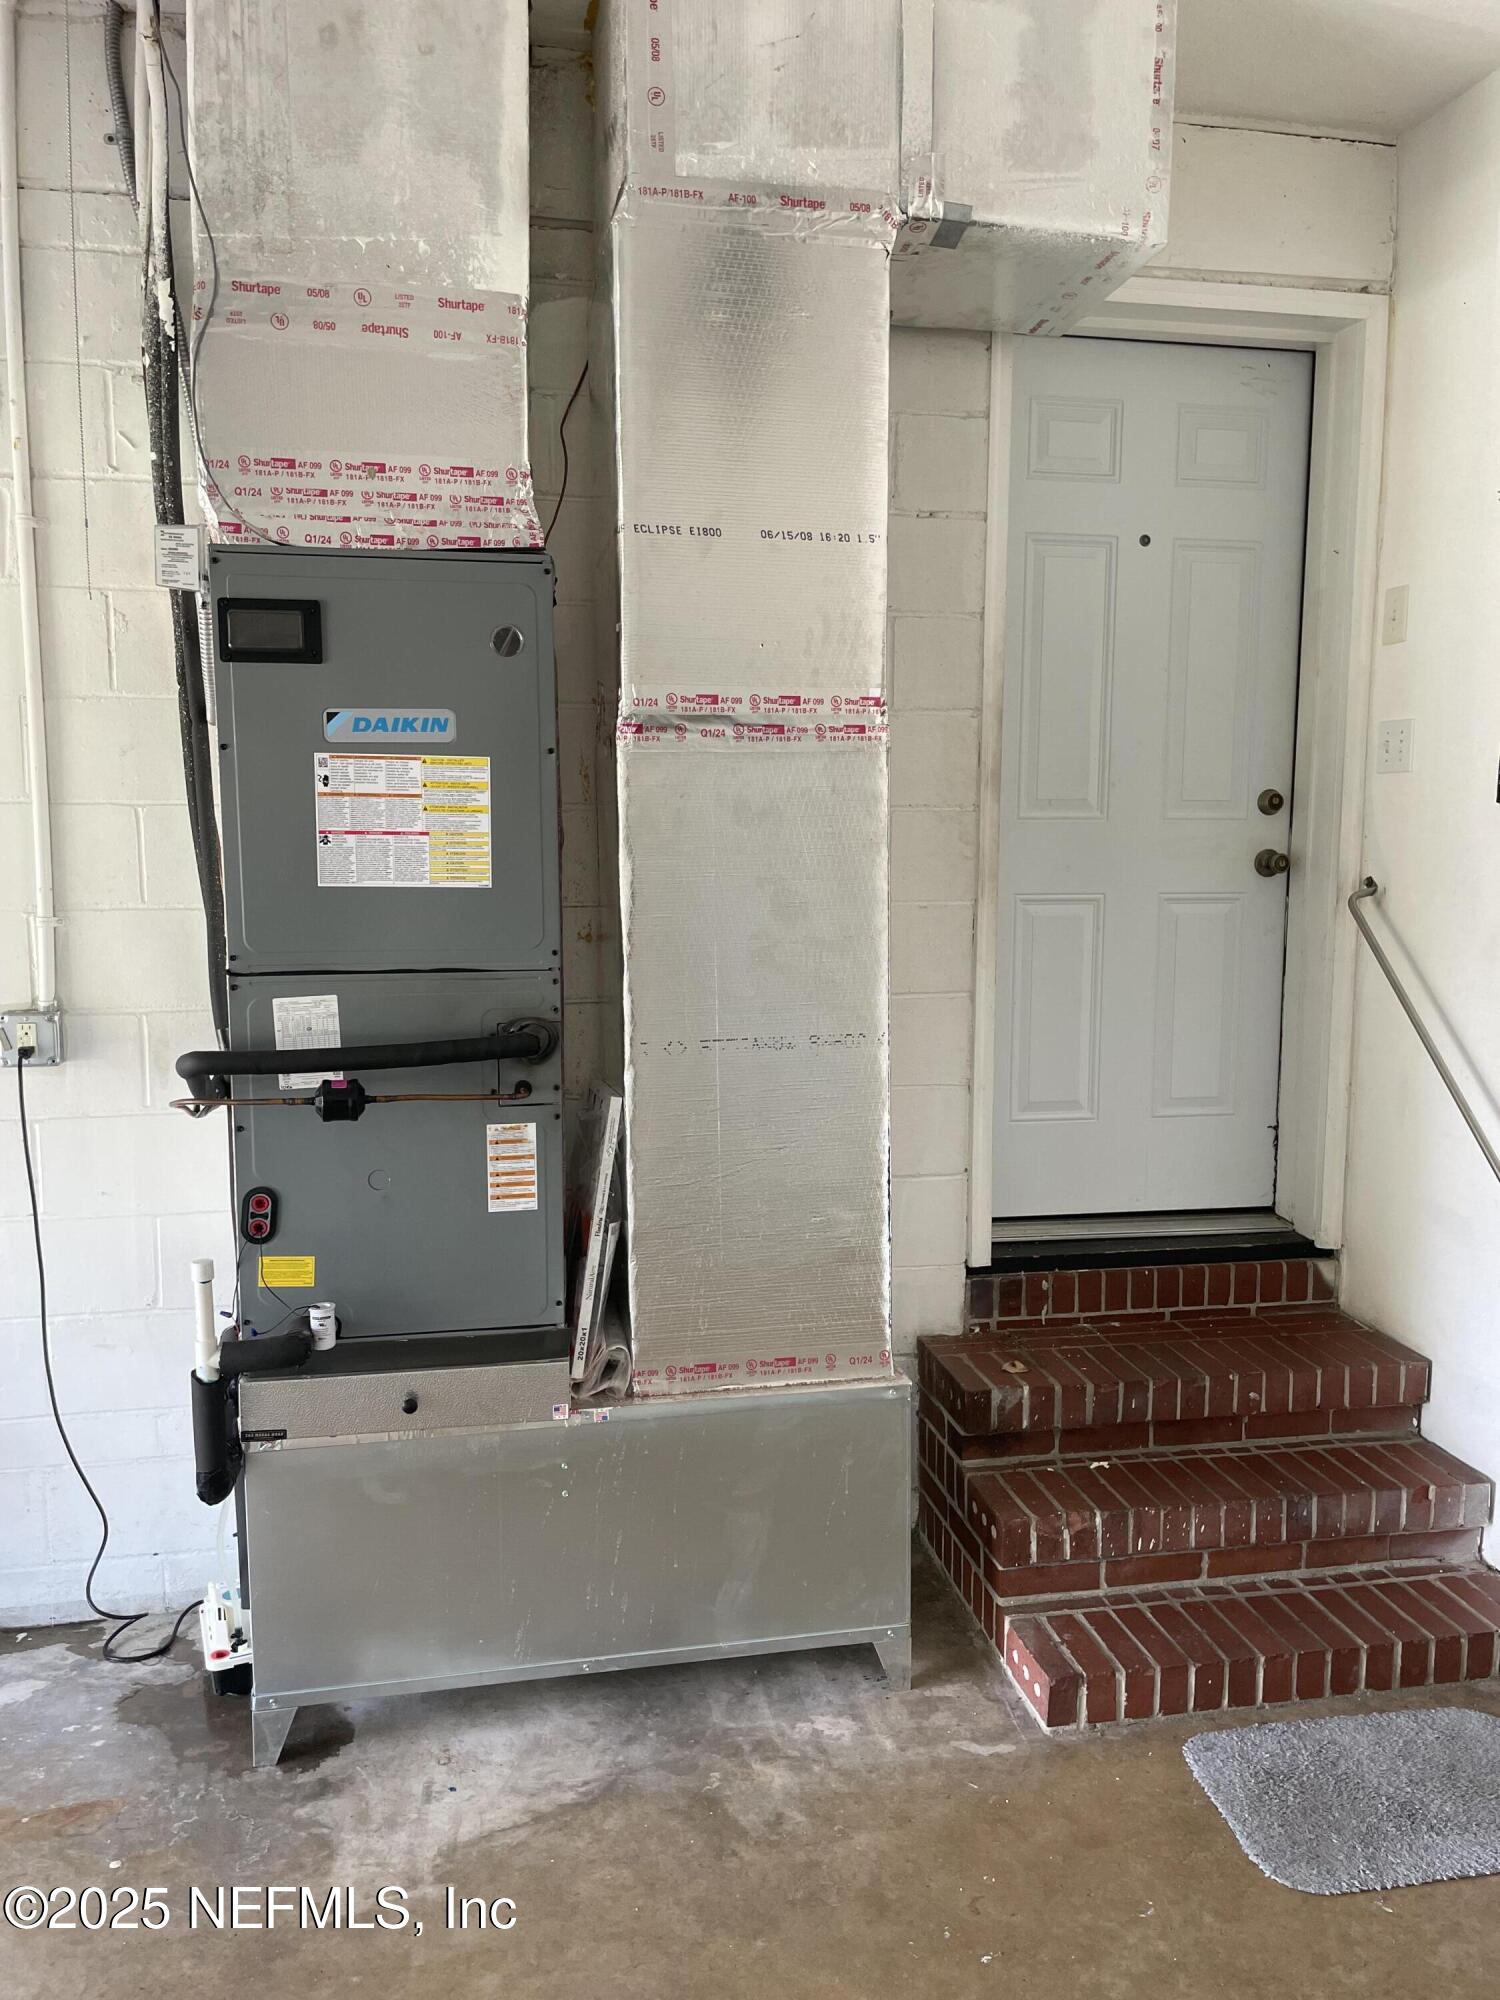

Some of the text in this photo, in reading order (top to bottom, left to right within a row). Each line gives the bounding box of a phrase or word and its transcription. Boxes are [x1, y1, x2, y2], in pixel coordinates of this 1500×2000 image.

[651, 37, 660, 62] 05/08
[728, 192, 757, 205] AF-100
[780, 195, 826, 211] Shurtape
[850, 202, 871, 213] 05/08
[231, 280, 281, 296] Shurtape
[307, 287, 330, 299] 05/08
[437, 297, 485, 313] Shurtape
[313, 320, 336, 331] 05/08
[361, 322, 409, 339] Shurtape
[433, 329, 462, 341] AF-100
[253, 458, 291, 470] Shurtape
[297, 461, 308, 469] AF
[309, 462, 322, 470] 099
[387, 465, 398, 473] AF
[399, 466, 412, 474] 099
[433, 466, 470, 478] Shurtape
[475, 469, 486, 477] AF
[486, 470, 499, 478] 099
[234, 486, 262, 497] Q1/24
[285, 487, 324, 498] Shurtape
[329, 489, 340, 497] AF
[341, 490, 354, 498] 099
[376, 491, 413, 502] Shurtape
[418, 493, 429, 501] AF
[430, 494, 443, 502] 099
[464, 495, 500, 507] Shurtape
[505, 498, 516, 506] AF
[304, 533, 332, 545] Q1/24
[396, 537, 407, 545] AF
[407, 537, 420, 546] 099
[441, 536, 478, 548] Shurtape
[482, 539, 493, 547] AF
[493, 539, 506, 547] 099
[633, 523, 683, 536] ECLIPSE
[760, 529, 813, 541] 06/15/08
[820, 531, 851, 543] 16:20
[633, 697, 658, 707] Q1/24
[679, 694, 715, 706] Shurtape
[730, 697, 743, 705] 099
[763, 696, 797, 707] Shurtape
[812, 698, 825, 706] 099
[844, 696, 878, 708] Shurtape
[352, 716, 449, 733] DAIKIN
[700, 728, 726, 738] Q1/24
[746, 724, 781, 735] Shurtape
[786, 726, 796, 734] AF
[797, 726, 809, 734] 099
[828, 724, 862, 735] Shurtape
[577, 1327, 588, 1361] 20x20x1
[849, 1356, 873, 1366] Q1/24
